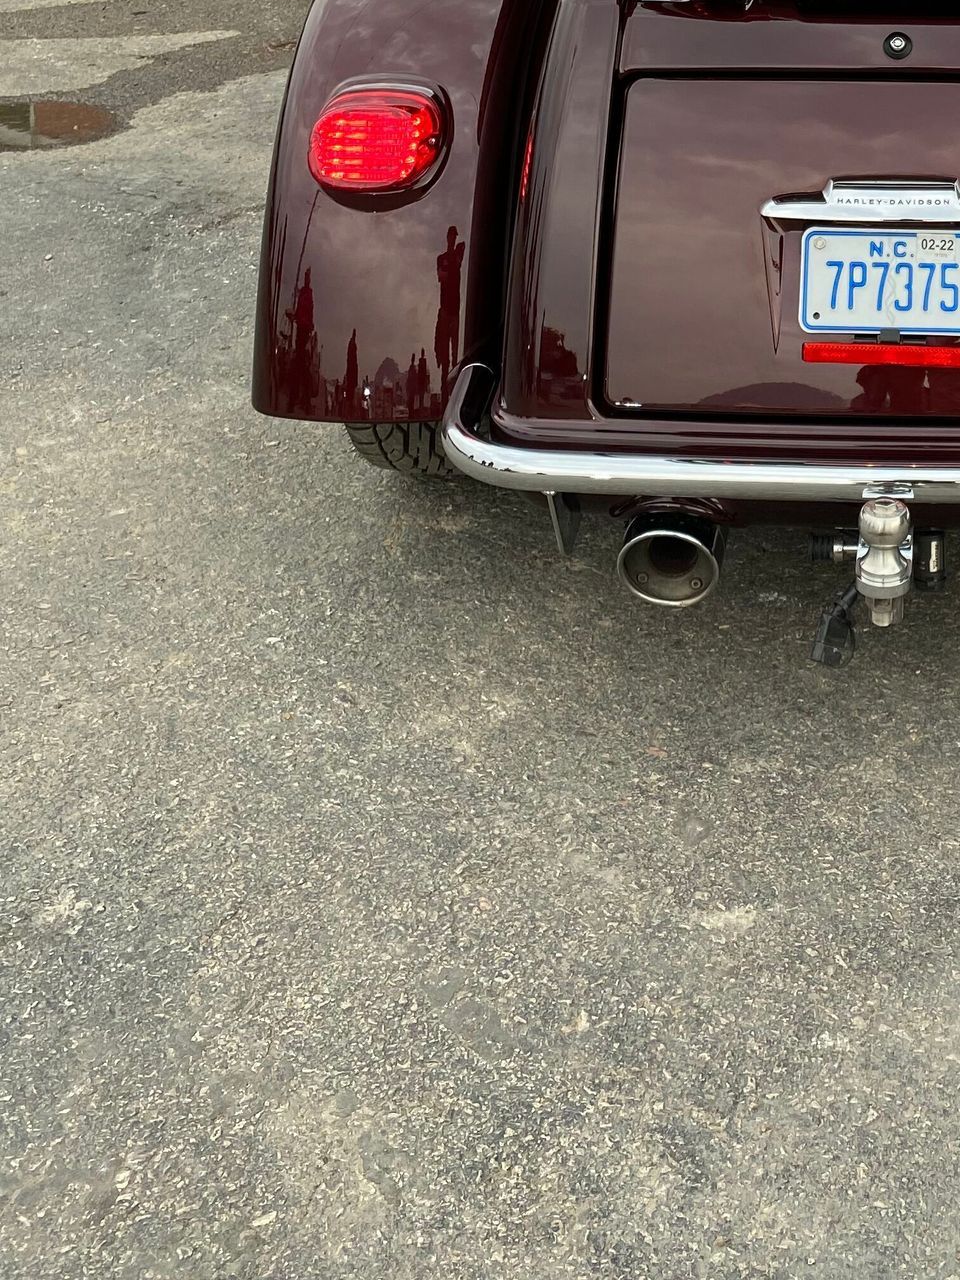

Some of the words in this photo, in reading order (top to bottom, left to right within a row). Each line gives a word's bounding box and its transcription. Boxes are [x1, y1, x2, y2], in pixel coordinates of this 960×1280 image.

[837, 197, 950, 206] HARLEY-DAVIDSON
[869, 240, 915, 258] N.C.
[920, 238, 955, 251] 02-22
[825, 260, 960, 312] 7P7375
